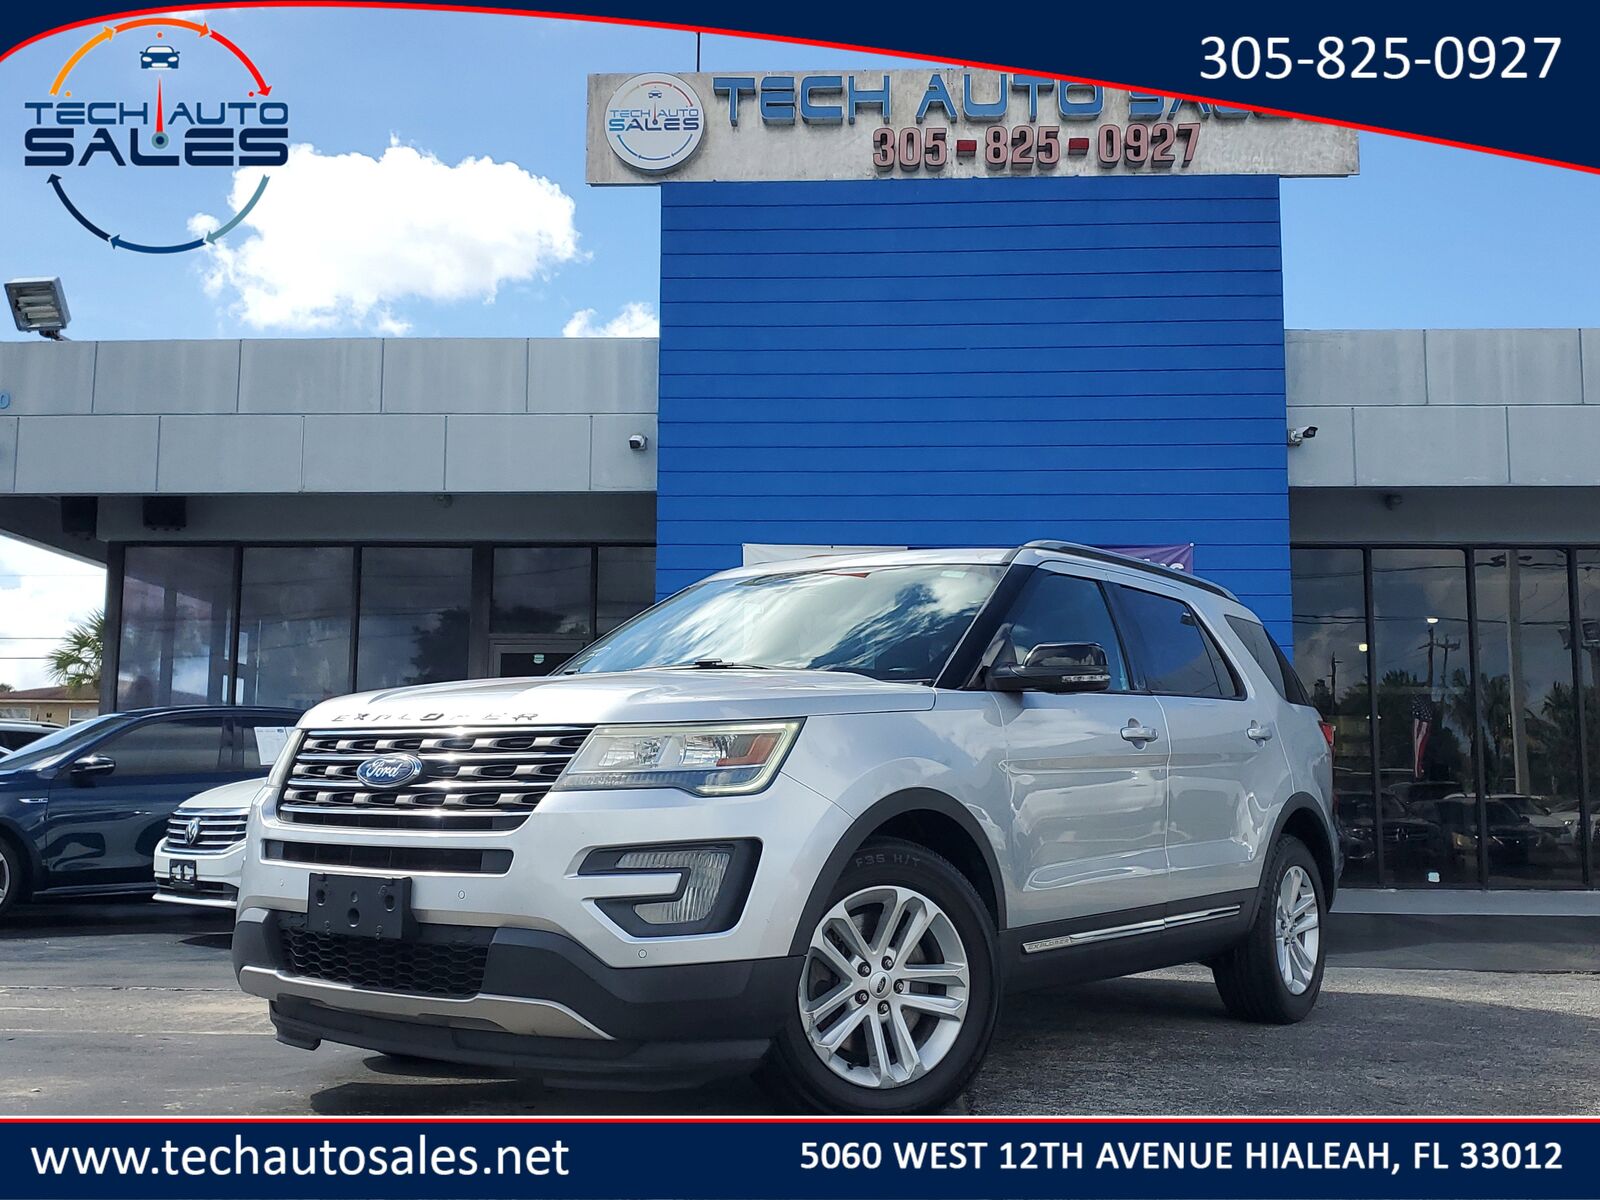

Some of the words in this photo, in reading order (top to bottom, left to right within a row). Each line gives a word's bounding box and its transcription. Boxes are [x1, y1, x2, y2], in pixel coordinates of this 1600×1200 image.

[712, 75, 891, 126] TECH
[916, 73, 1104, 122] AUTO
[609, 109, 650, 118] TECH
[657, 108, 699, 117] AUTO
[609, 117, 699, 131] SALES
[872, 122, 1201, 170] 305-825-0927
[366, 759, 403, 778] Ford
